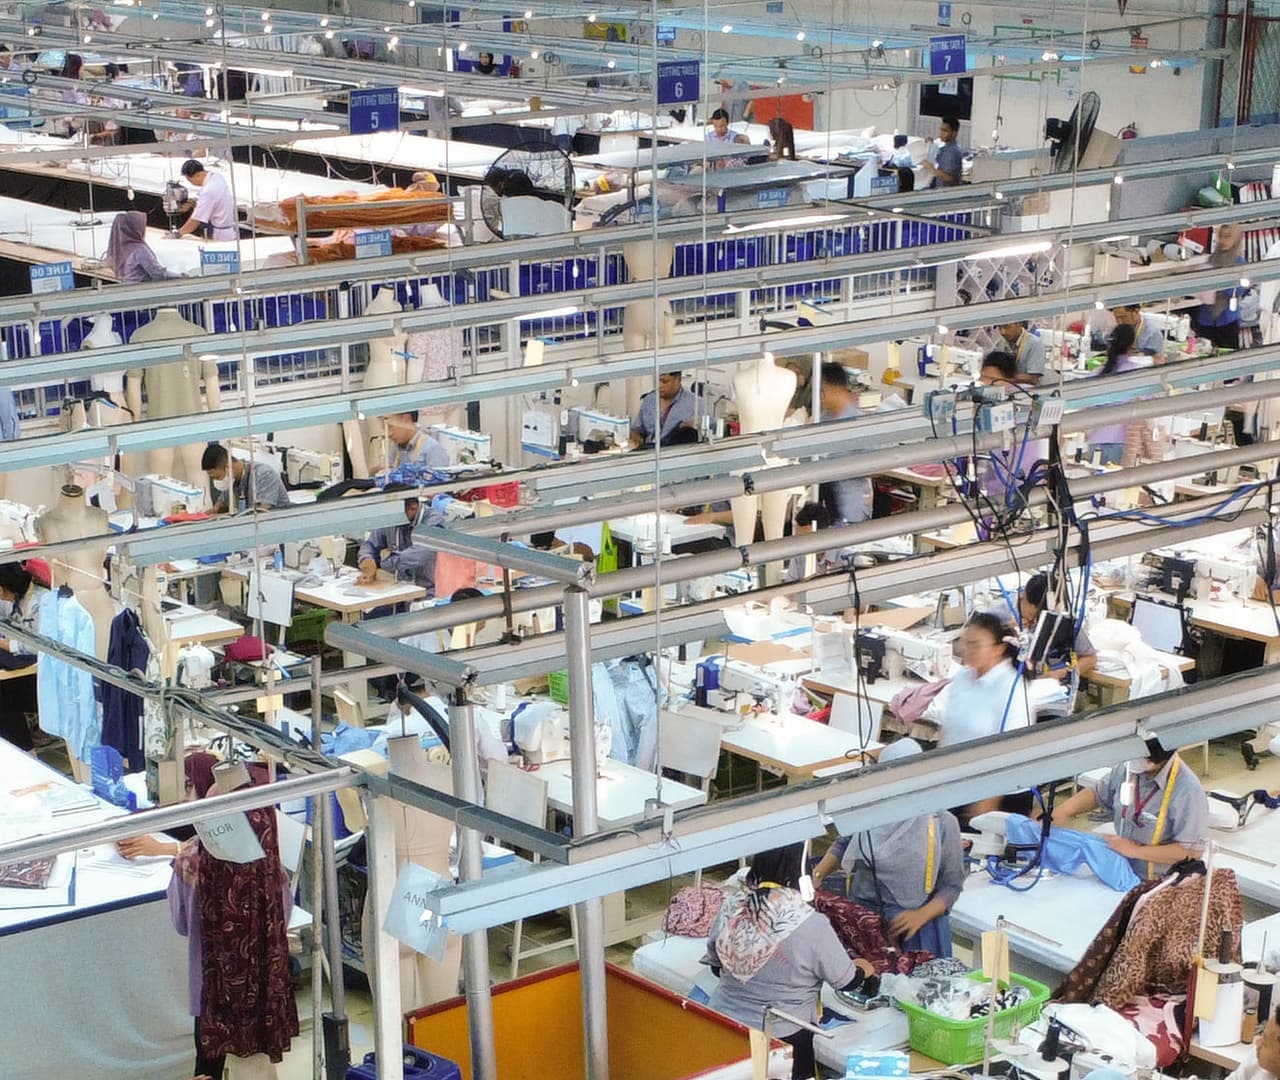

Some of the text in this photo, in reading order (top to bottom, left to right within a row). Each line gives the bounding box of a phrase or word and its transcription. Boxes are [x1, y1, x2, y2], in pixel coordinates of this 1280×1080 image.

[943, 55, 951, 71] 7
[674, 82, 683, 98] 6
[371, 112, 379, 129] 5
